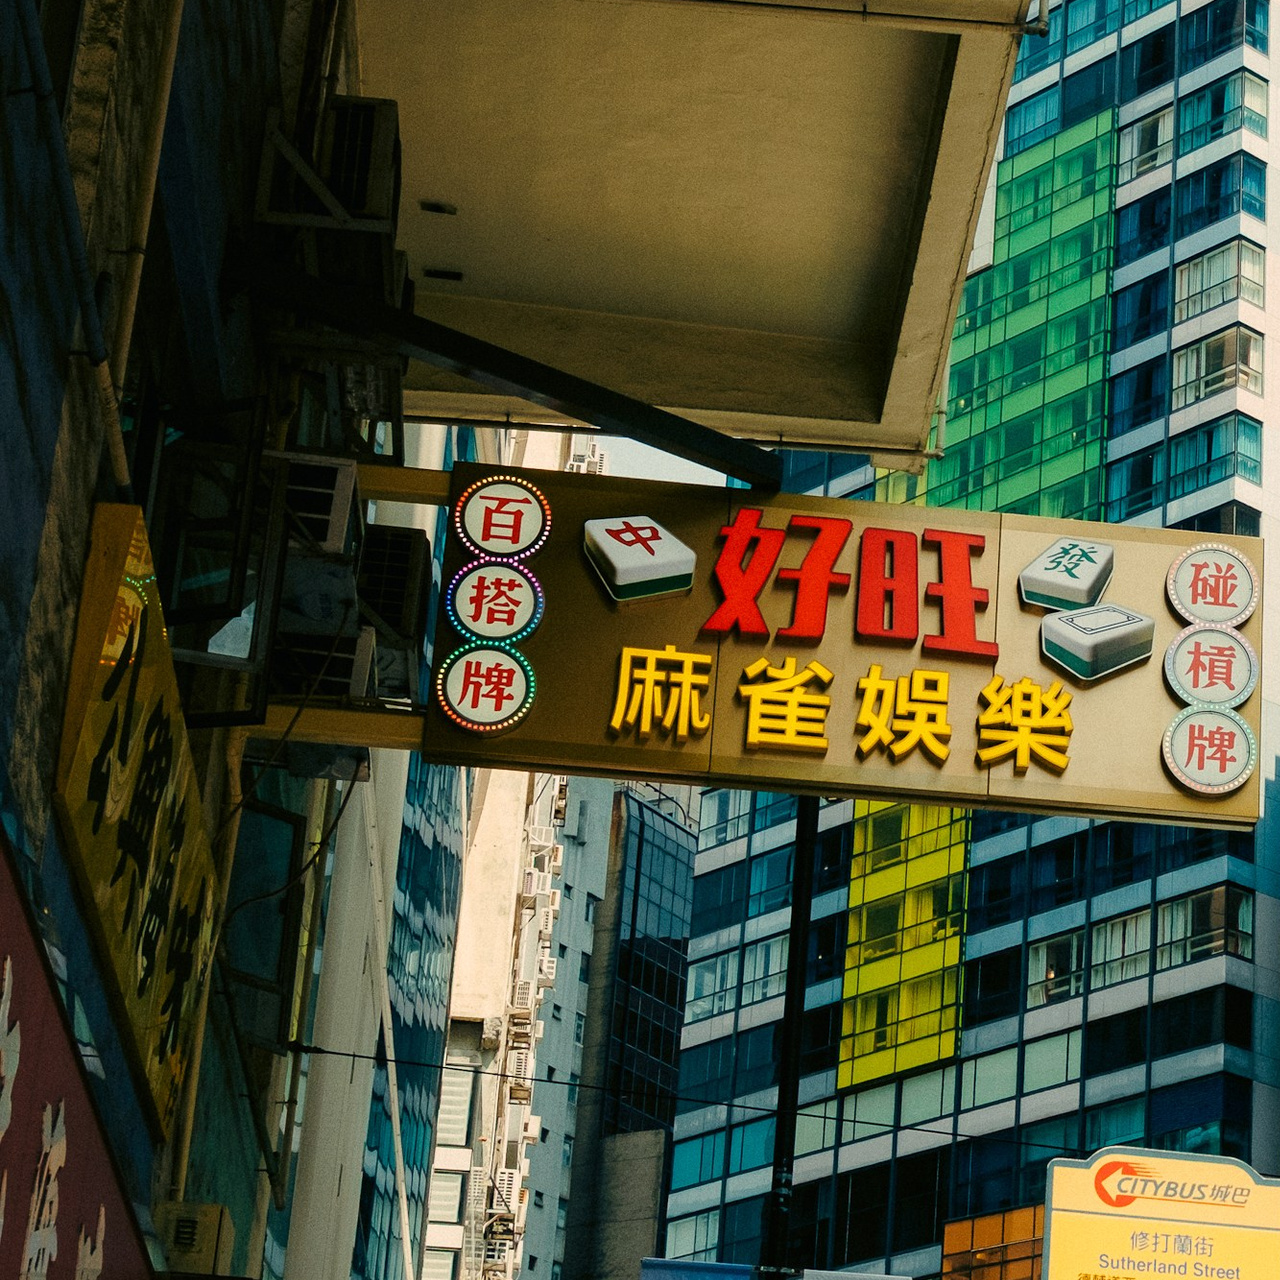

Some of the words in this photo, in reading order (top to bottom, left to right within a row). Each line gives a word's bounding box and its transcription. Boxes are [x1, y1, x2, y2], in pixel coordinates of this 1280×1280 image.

[610, 519, 662, 557] 中
[458, 493, 535, 714] 百搭牌
[702, 506, 999, 663] 好旺
[610, 644, 1075, 774] 麻雀娛樂
[1184, 560, 1241, 775] 碰槓牌
[1117, 1175, 1207, 1201] CITYBUS
[1210, 1184, 1251, 1206] 城巴
[1098, 1253, 1188, 1277] Sutherland
[1192, 1264, 1241, 1280] Street
[1129, 1230, 1215, 1258] 修打蘭街
